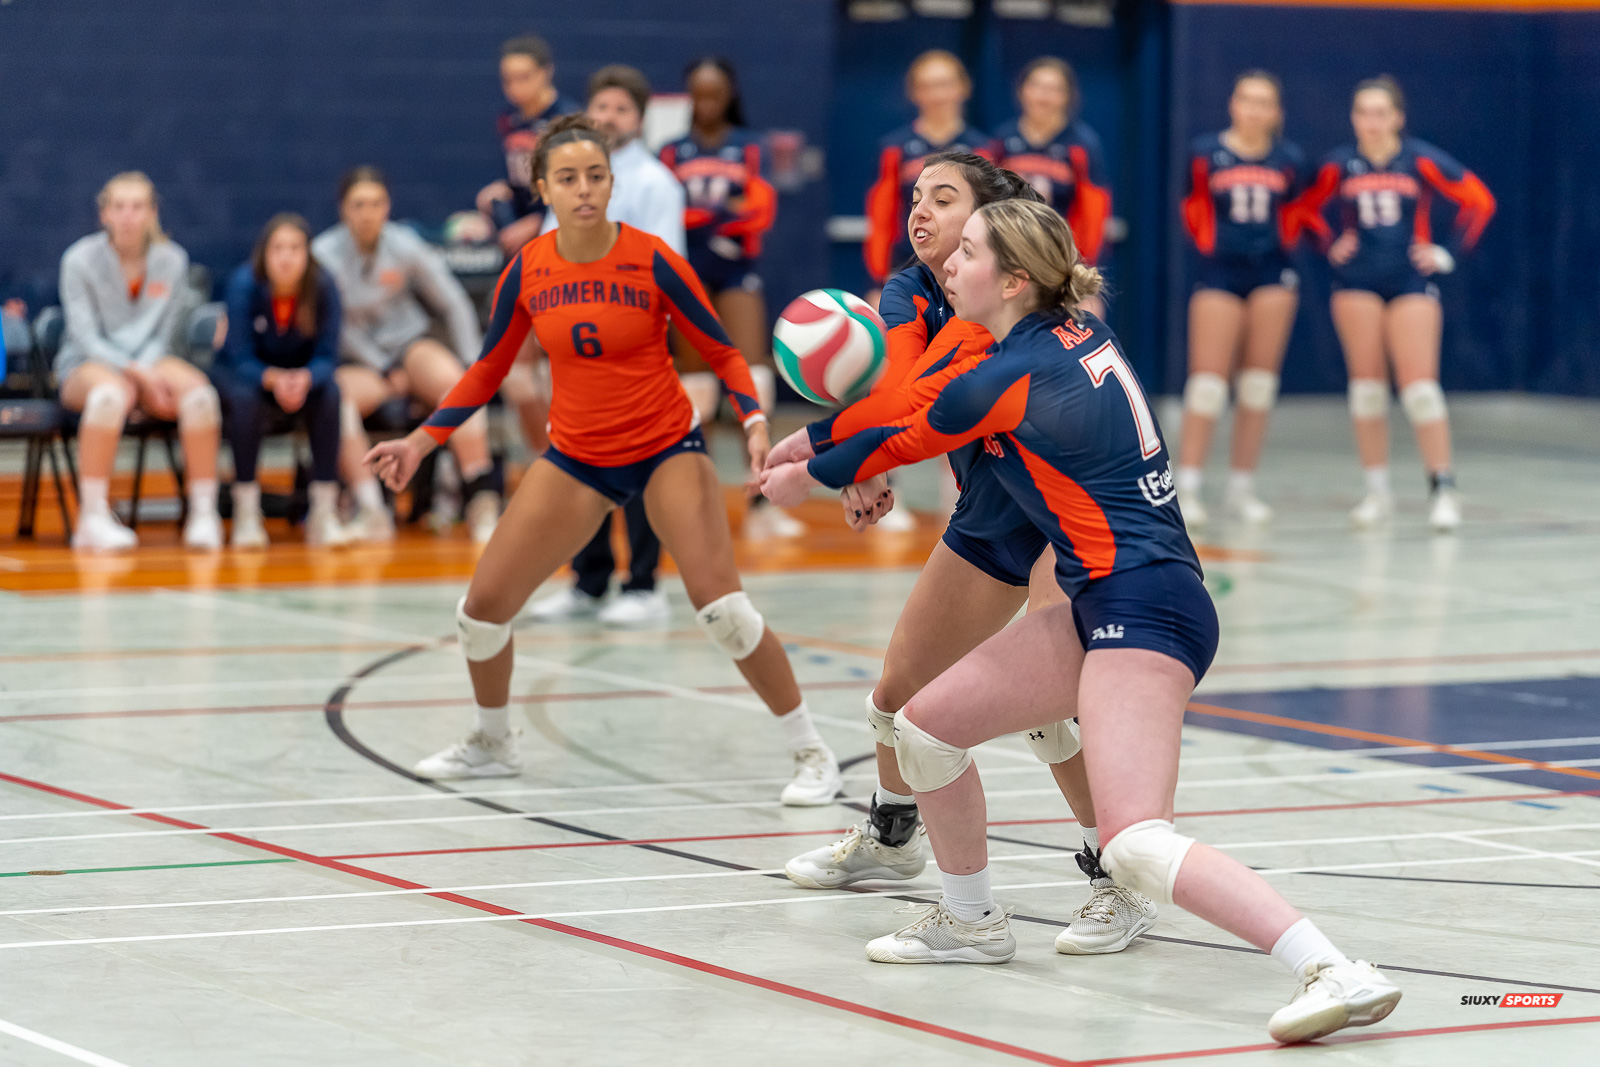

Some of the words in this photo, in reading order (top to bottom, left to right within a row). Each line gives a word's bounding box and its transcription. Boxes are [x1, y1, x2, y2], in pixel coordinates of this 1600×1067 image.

[529, 280, 650, 315] BOOMERANG
[571, 321, 603, 358] 6
[1051, 318, 1094, 350] AL
[1078, 338, 1162, 462] 7
